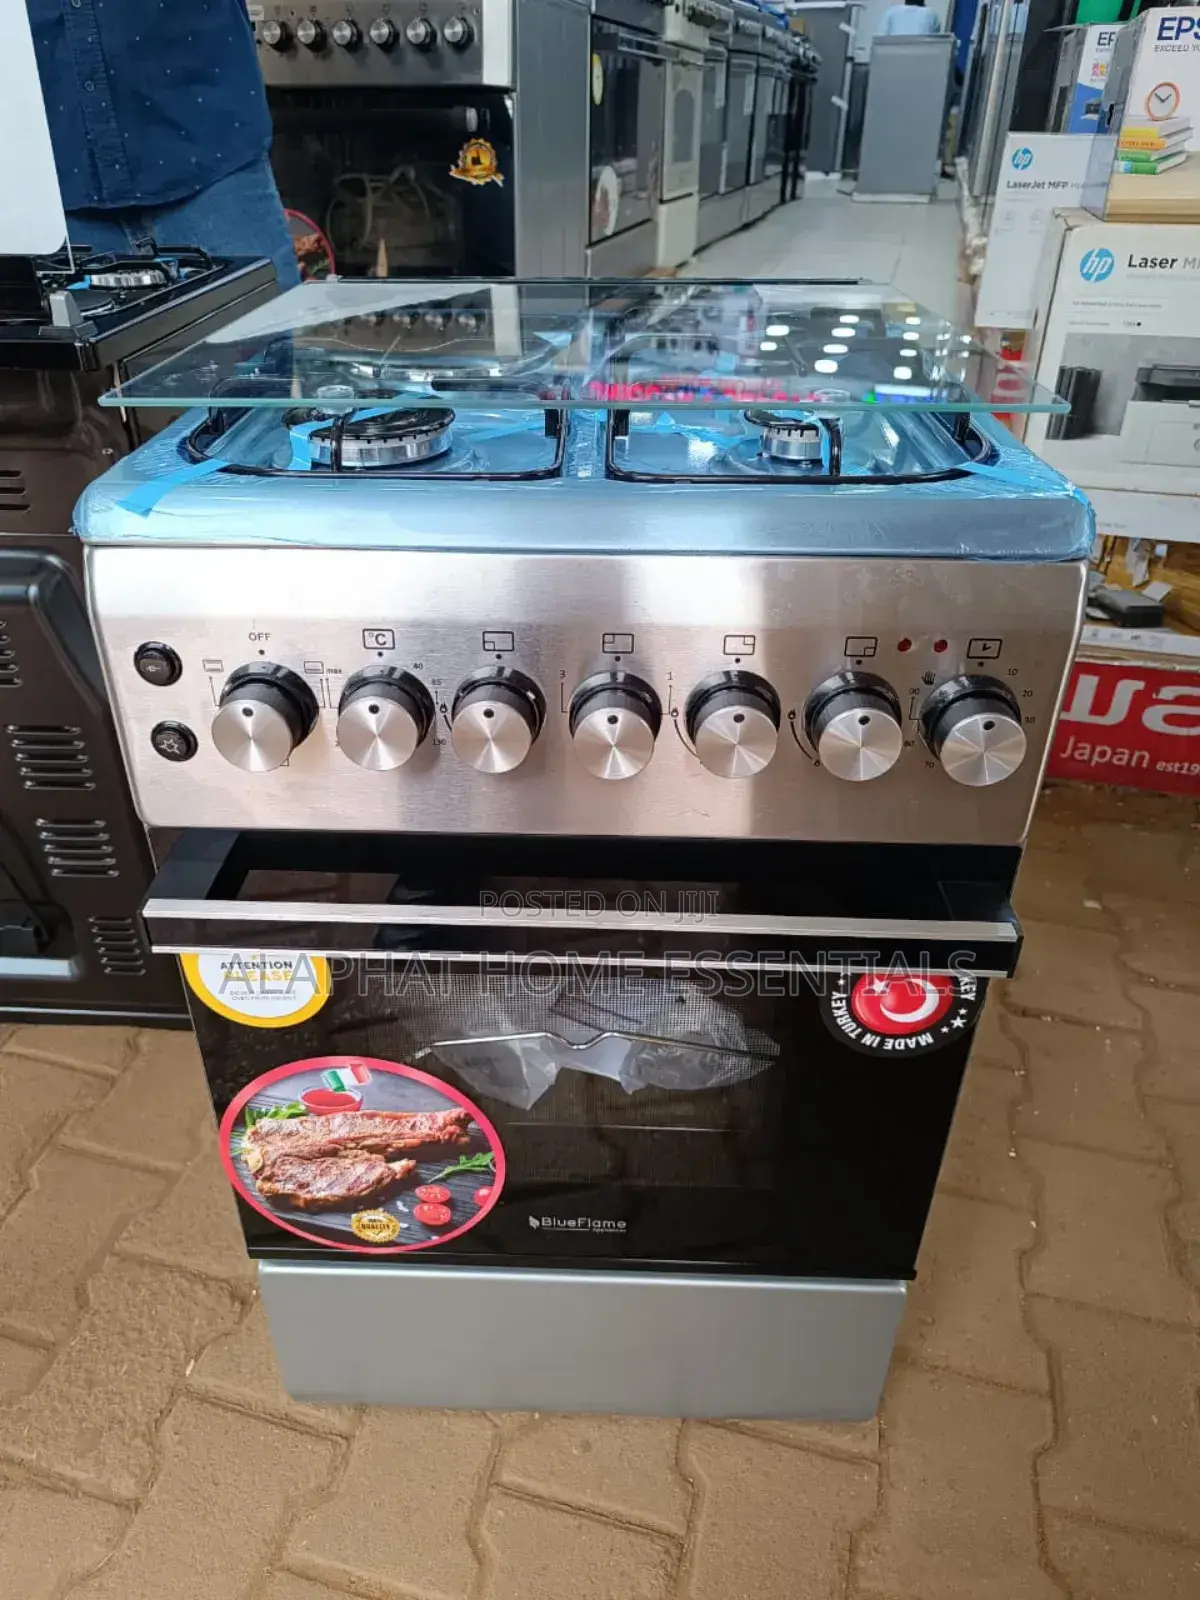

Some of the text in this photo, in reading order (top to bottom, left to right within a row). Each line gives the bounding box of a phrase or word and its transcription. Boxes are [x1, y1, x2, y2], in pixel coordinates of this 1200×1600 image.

[1154, 44, 1190, 52] EXCEED
[1012, 147, 1033, 170] hp
[1007, 180, 1045, 189] LaserJet
[1048, 180, 1069, 189] MFP
[1080, 248, 1114, 283] hp
[1128, 253, 1178, 269] Laser
[248, 632, 271, 641] OFF
[560, 669, 566, 679] 3
[1006, 668, 1019, 676] 10
[909, 687, 920, 695] 90
[1060, 734, 1150, 768] Japan
[221, 961, 293, 970] ATTENTION
[831, 991, 934, 1050] MADE IN TURKEY
[541, 1216, 627, 1229] BlueFlame
